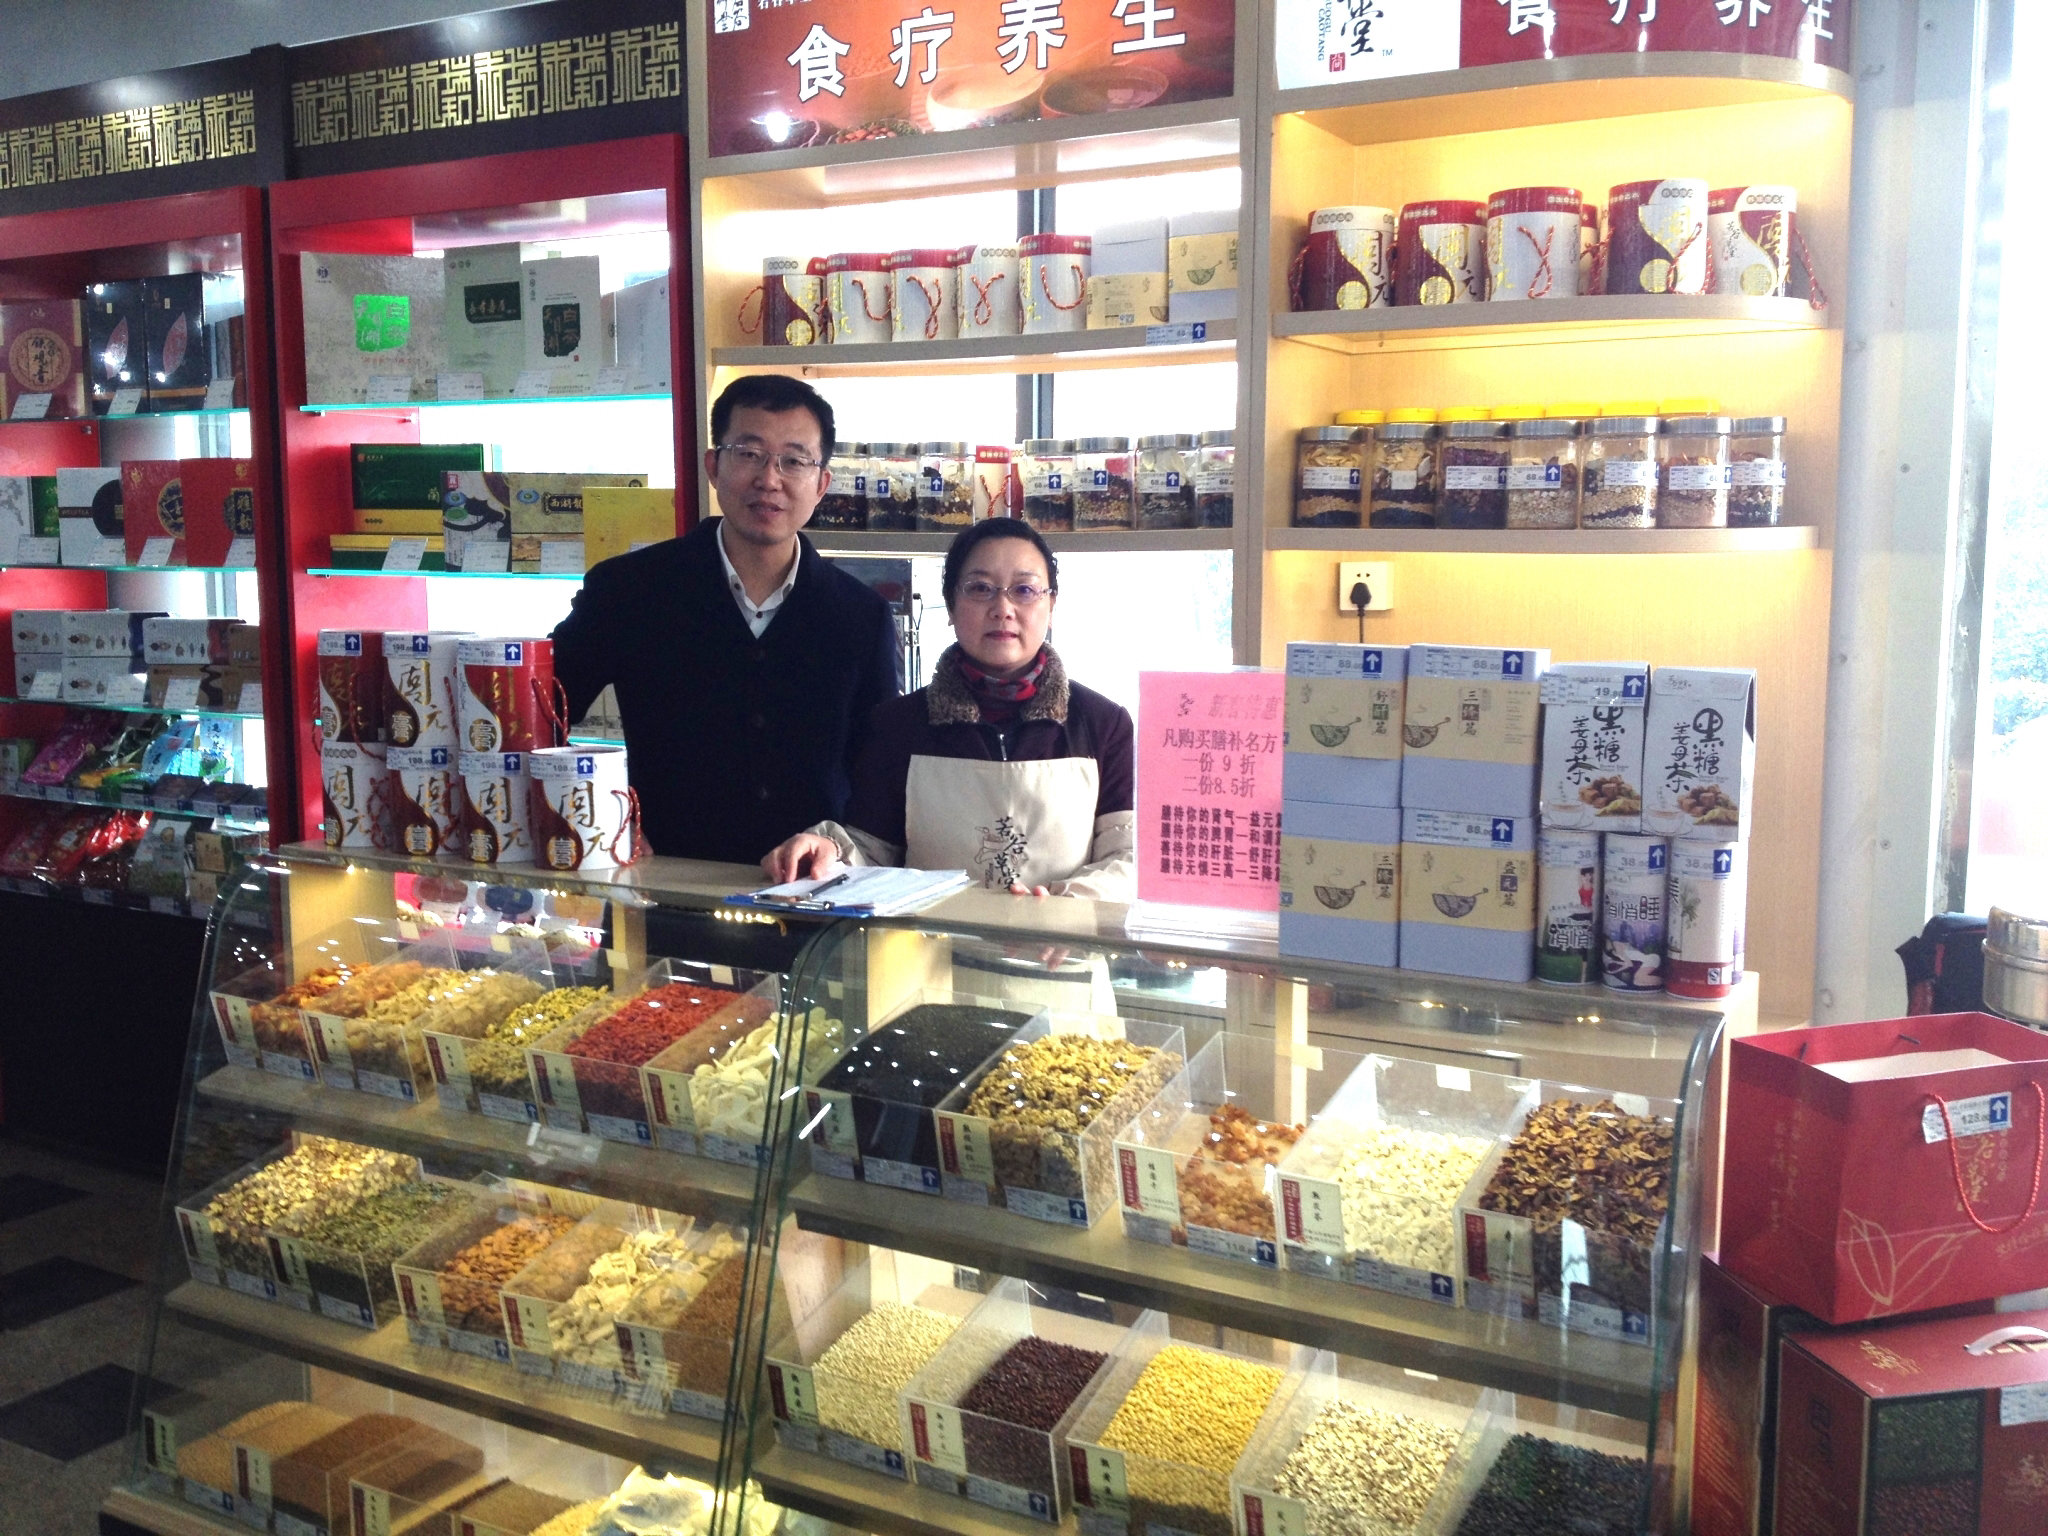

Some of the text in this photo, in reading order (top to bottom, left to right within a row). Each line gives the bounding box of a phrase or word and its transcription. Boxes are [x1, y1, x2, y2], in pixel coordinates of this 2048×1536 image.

[787, 0, 1187, 102] 食疗养生
[1317, 8, 1326, 61] CAOTANG
[1162, 728, 1279, 754] 凡购买膳补名方
[1223, 757, 1231, 773] 9
[1239, 754, 1256, 776] 折
[1692, 707, 1725, 776] 黑糖
